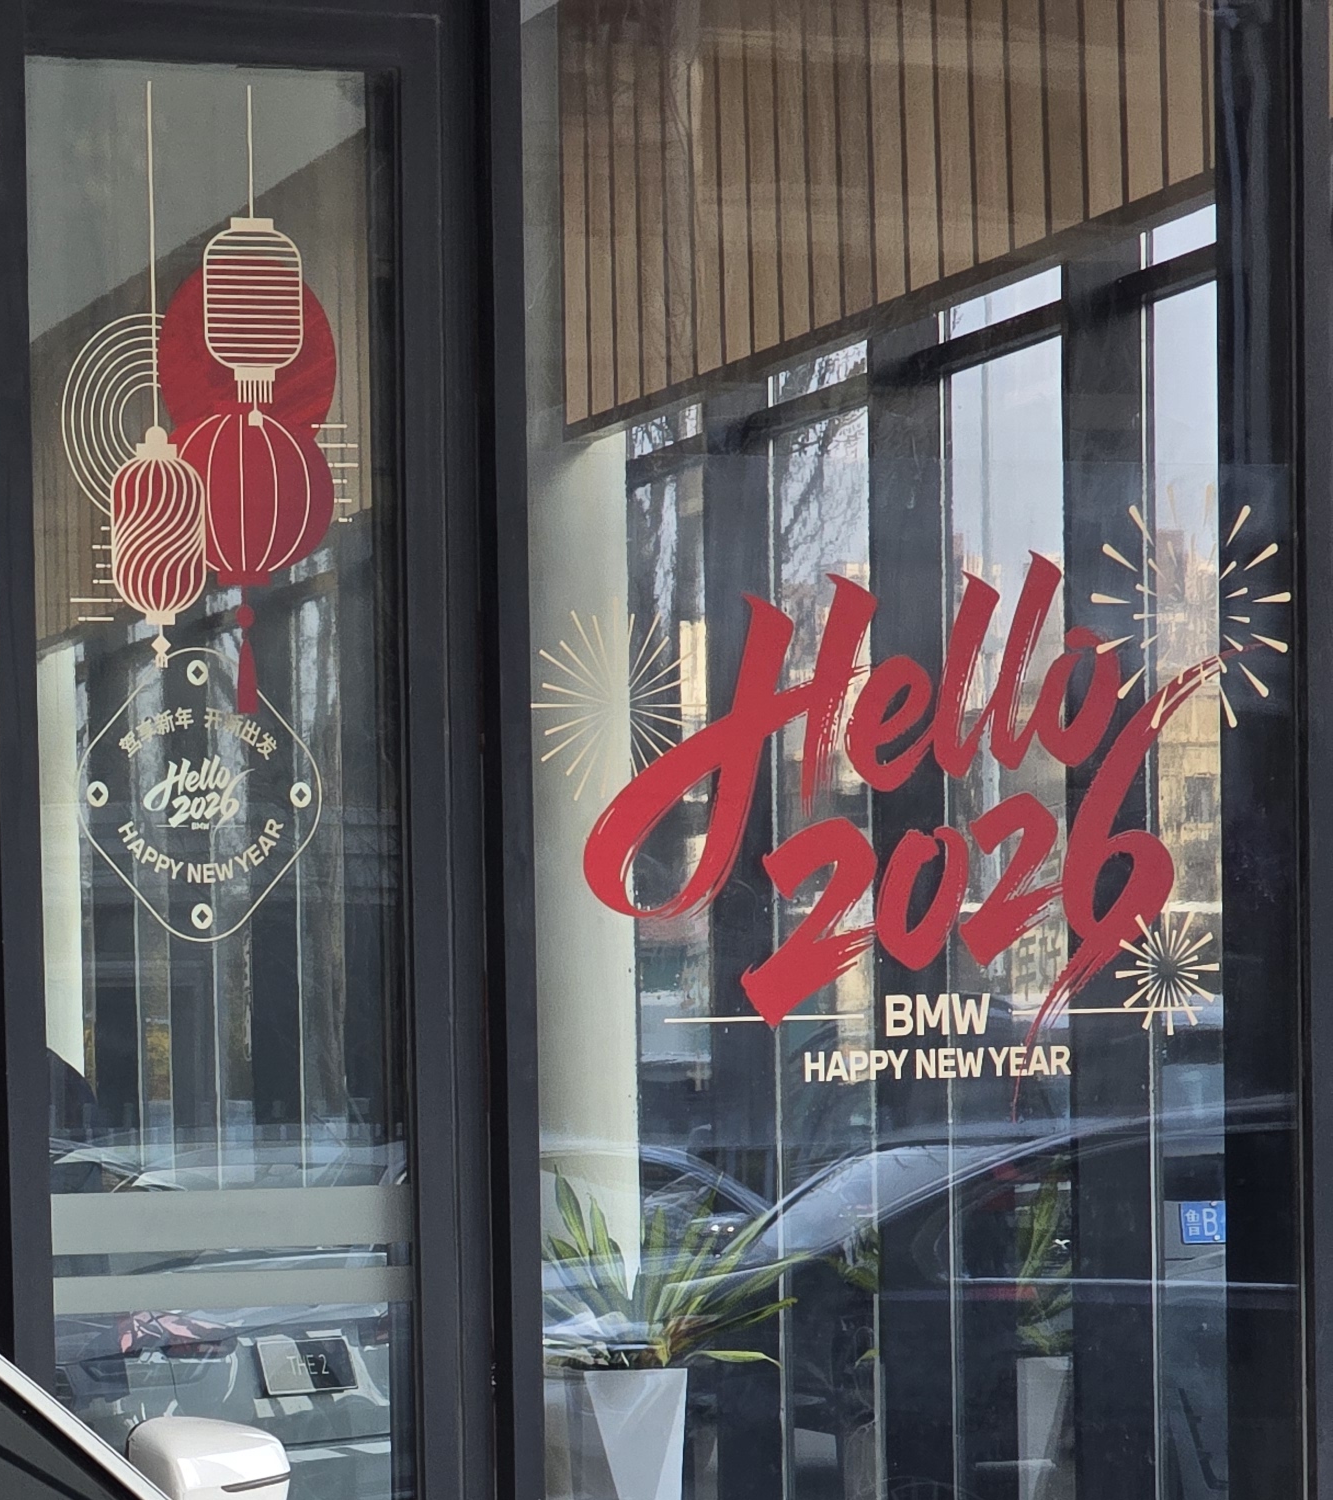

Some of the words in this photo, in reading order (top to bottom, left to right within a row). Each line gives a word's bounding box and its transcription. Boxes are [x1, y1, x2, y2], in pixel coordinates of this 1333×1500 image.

[583, 550, 1121, 919] Hello
[143, 755, 231, 812] Hello
[168, 775, 249, 831] 2026
[118, 821, 184, 880] HAPPY
[187, 860, 233, 883] NEW
[234, 819, 284, 873] YEAR
[741, 655, 1228, 1045] 2026
[885, 994, 990, 1037] BMW
[804, 1050, 906, 1082] HAPPY
[915, 1048, 984, 1079] NEW
[988, 1046, 1071, 1077] YEAR
[1184, 1208, 1225, 1237] 鲁B
[286, 1354, 319, 1377] THE
